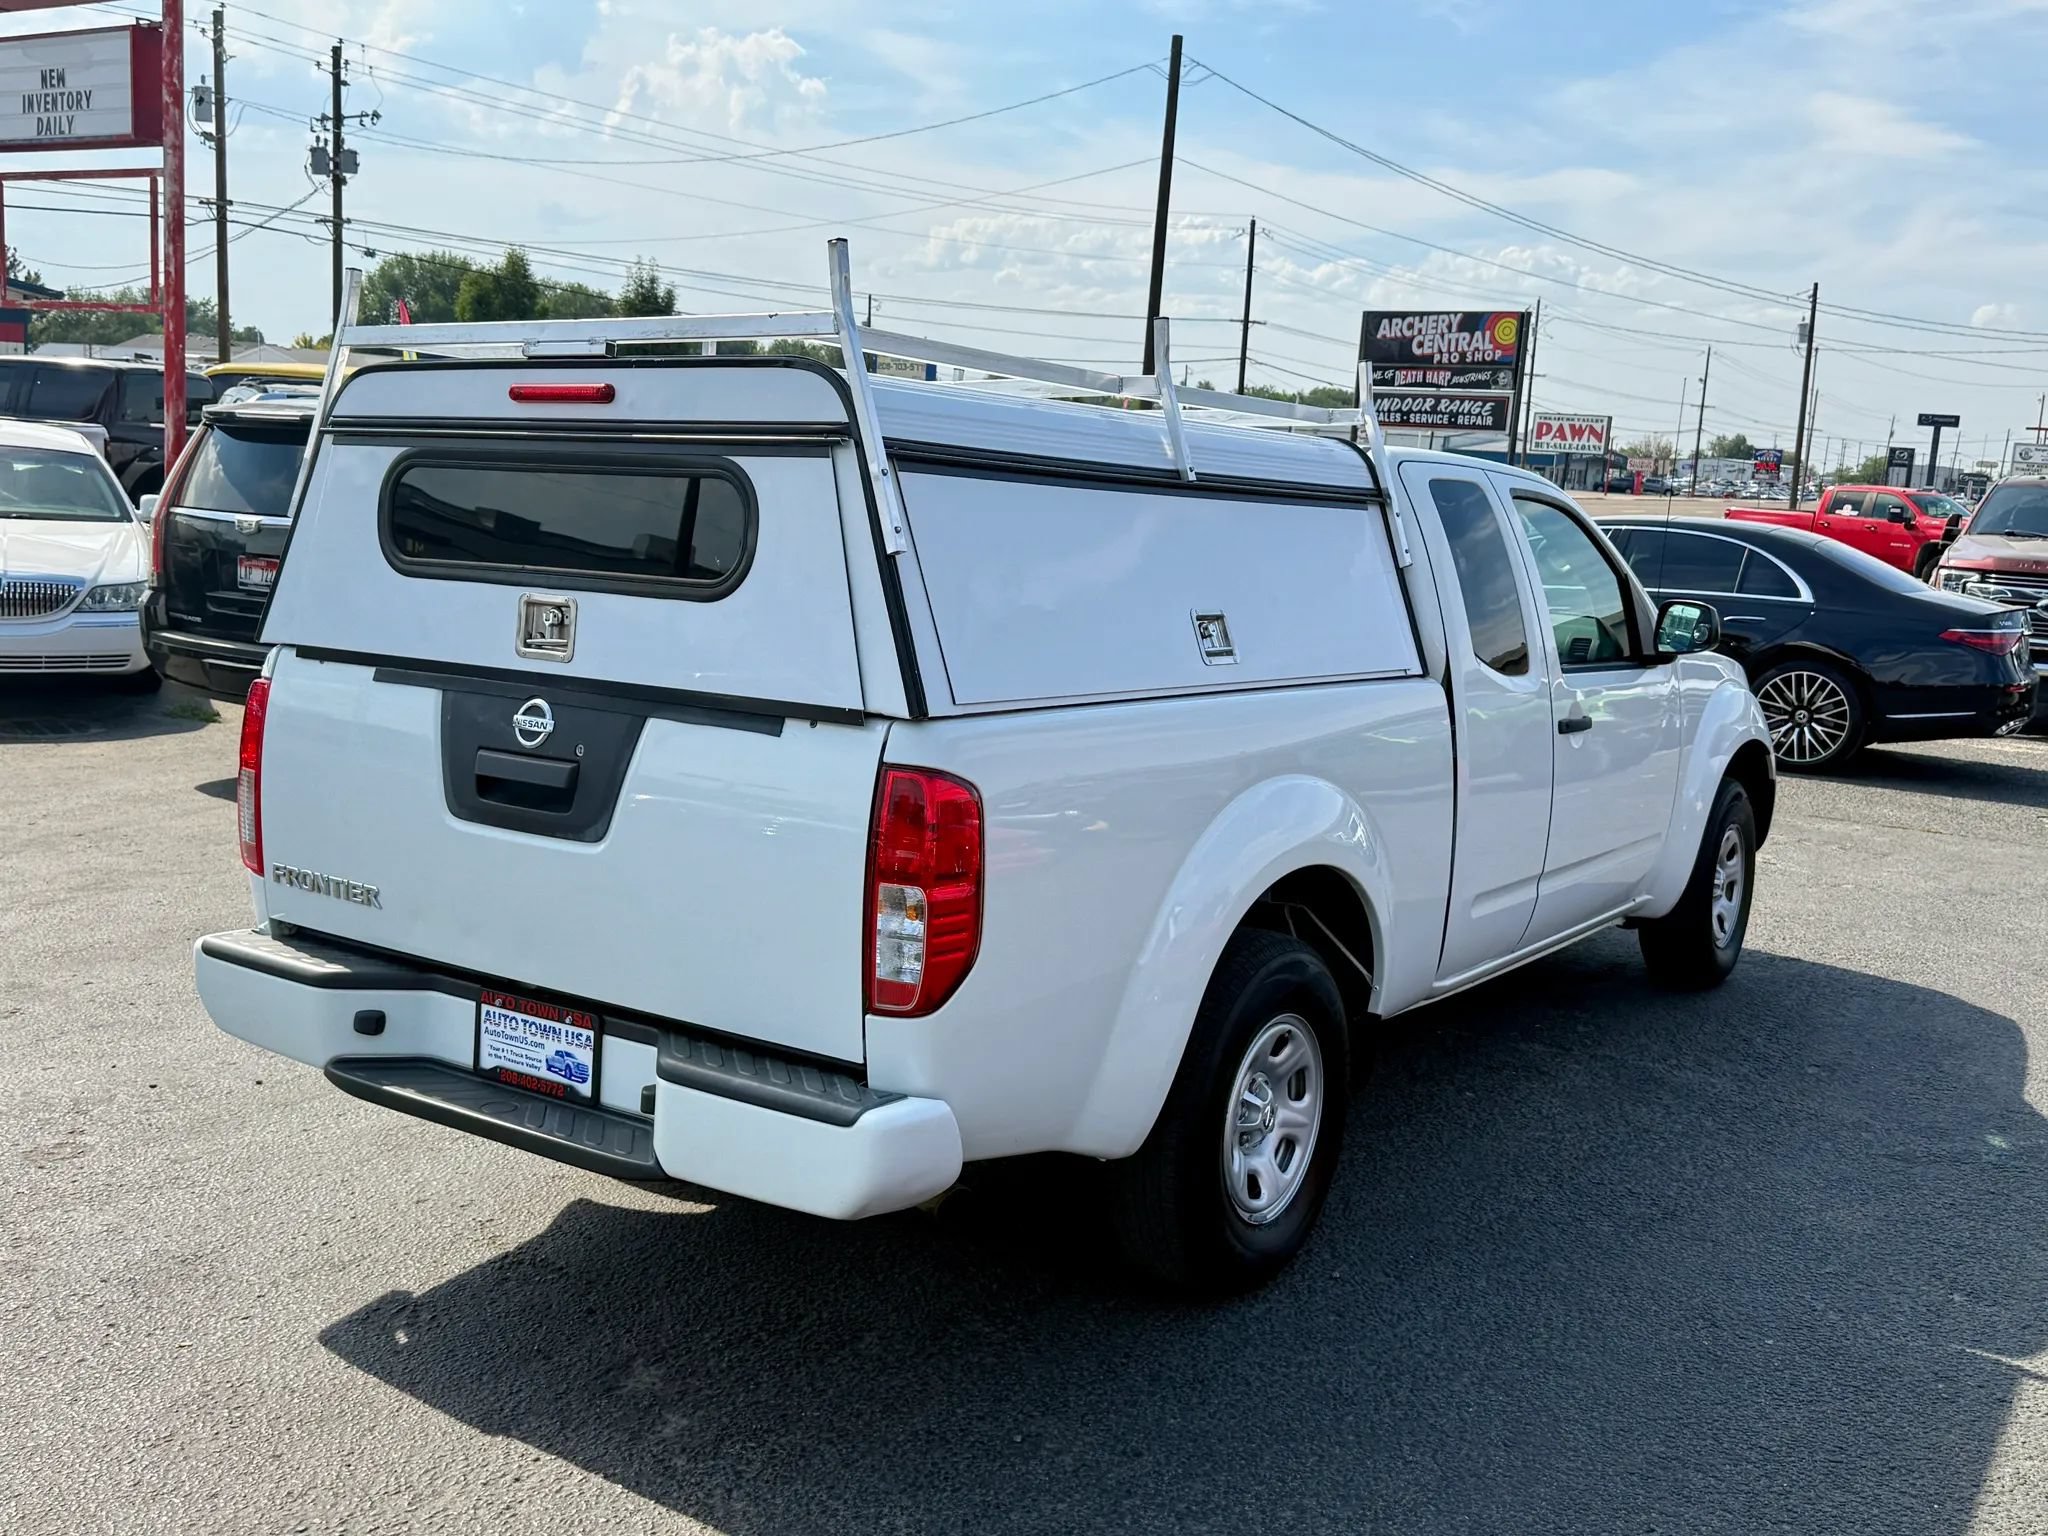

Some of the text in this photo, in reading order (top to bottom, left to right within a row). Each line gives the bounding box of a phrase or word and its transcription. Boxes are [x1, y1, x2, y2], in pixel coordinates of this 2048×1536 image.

[41, 68, 65, 89] NEW
[22, 90, 92, 114] INVENTORY
[36, 115, 75, 136] DAILY
[1376, 313, 1463, 338] ARCHERY
[1411, 330, 1493, 355] CENTRAL
[1433, 349, 1502, 364] PRO SHOP
[1394, 370, 1423, 387] DEATH
[1425, 370, 1452, 387] HARP
[1374, 397, 1495, 416] INDOOR RANGE
[1409, 413, 1449, 424] SERVICE
[1457, 415, 1493, 426] REPAIR
[1535, 421, 1605, 444] PAWN
[514, 716, 548, 730] NISSAN
[272, 862, 383, 910] FRONTIER
[481, 990, 593, 1029] AUTO TOWN USA
[483, 1026, 546, 1051] AutoTownUS.com
[564, 1029, 593, 1051] USA
